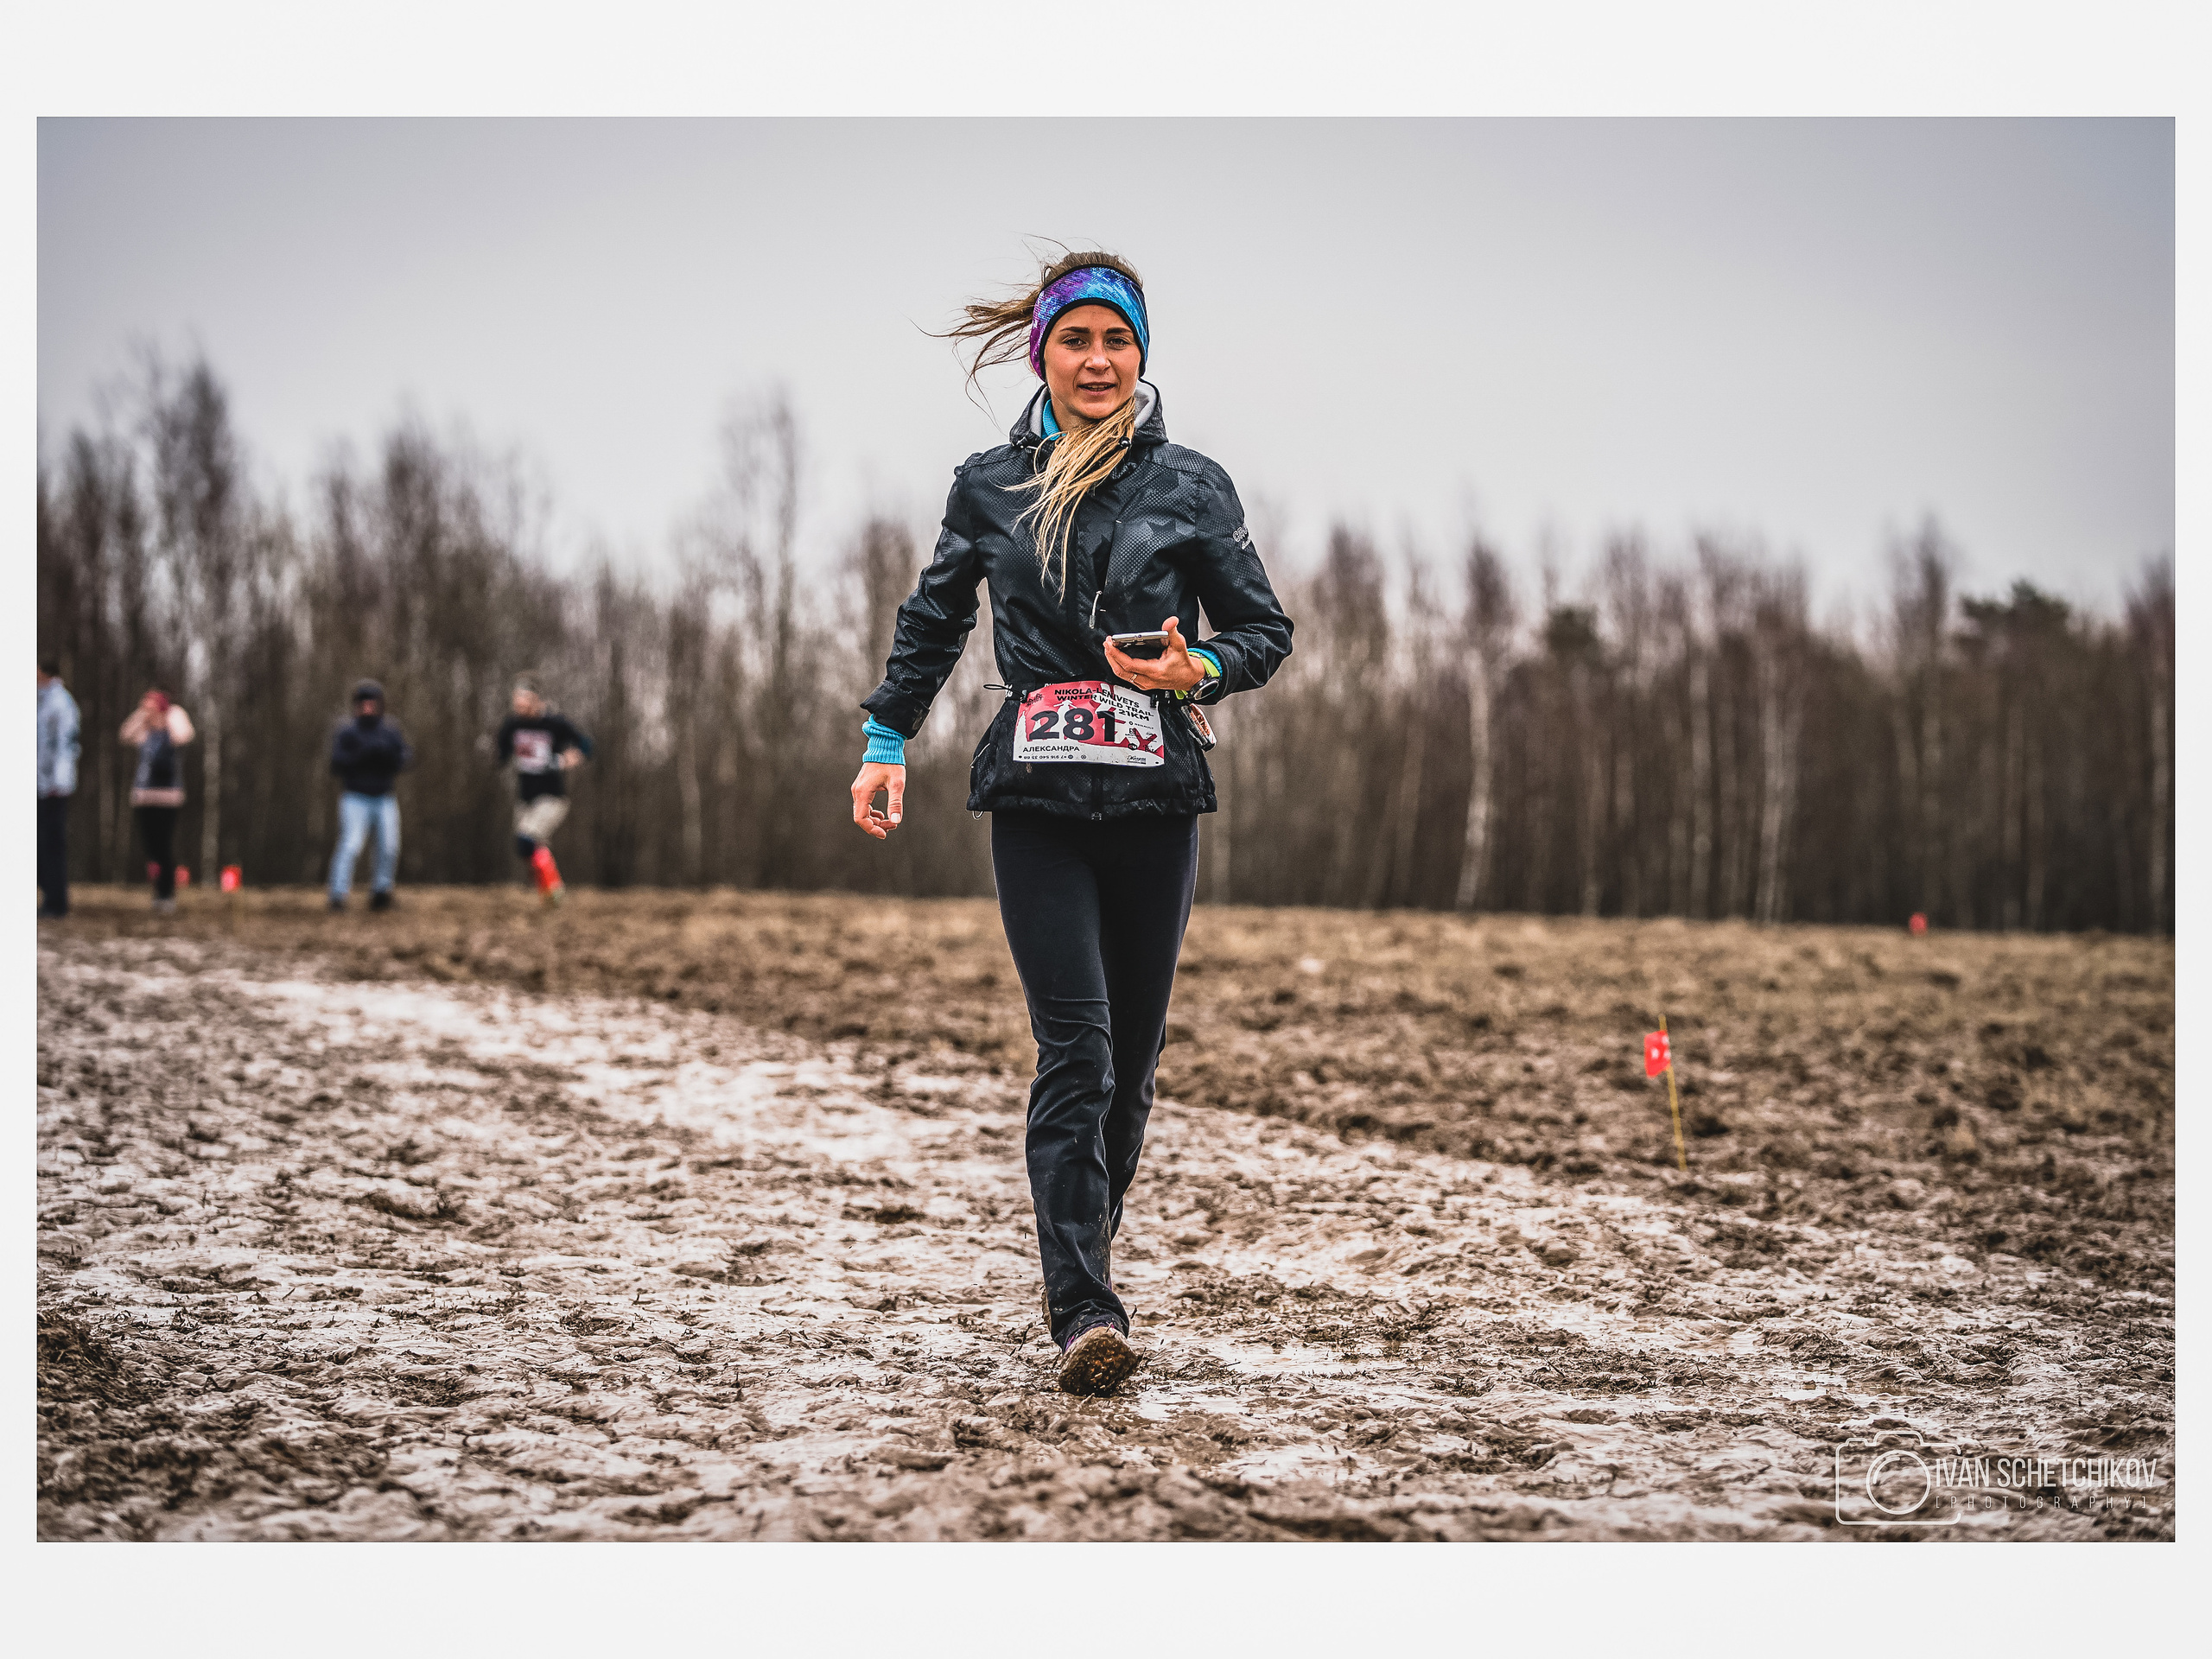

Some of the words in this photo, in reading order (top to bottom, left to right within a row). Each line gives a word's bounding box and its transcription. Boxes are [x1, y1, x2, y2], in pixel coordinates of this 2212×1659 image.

[1054, 688, 1140, 709] NIKOLA-LENIVETS
[1099, 695, 1123, 709] WILD
[1126, 704, 1154, 717] TRAIL
[1029, 708, 1116, 741] 281
[1119, 709, 1149, 721] 21KM
